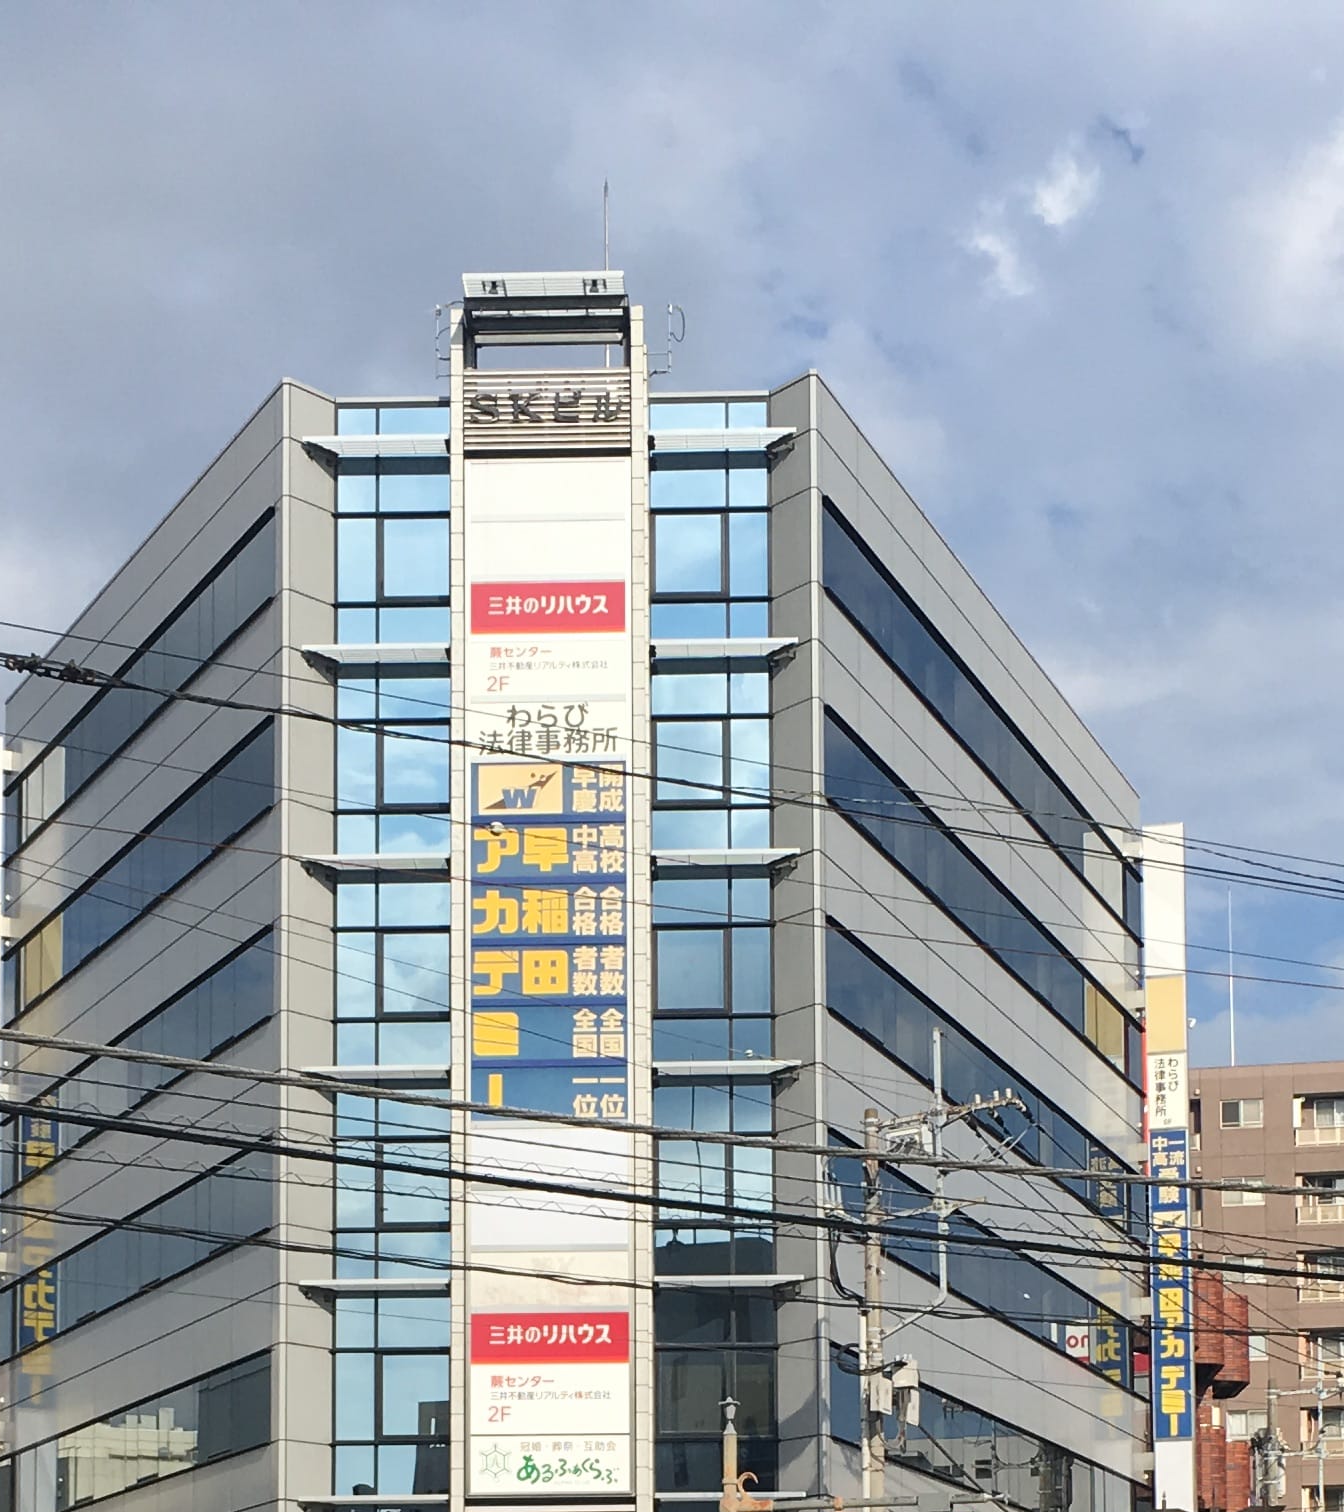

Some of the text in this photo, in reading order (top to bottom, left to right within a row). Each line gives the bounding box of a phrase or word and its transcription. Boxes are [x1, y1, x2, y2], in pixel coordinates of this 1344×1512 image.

[488, 594, 609, 616] 三井のリハウス
[486, 676, 510, 692] 2F
[506, 702, 589, 729] わらび
[478, 727, 618, 756] 法律事務所
[489, 1323, 612, 1345] 三井のリハウス
[490, 1390, 612, 1401] 三井不動産リアルティ株式会社
[487, 1405, 512, 1423] 2F
